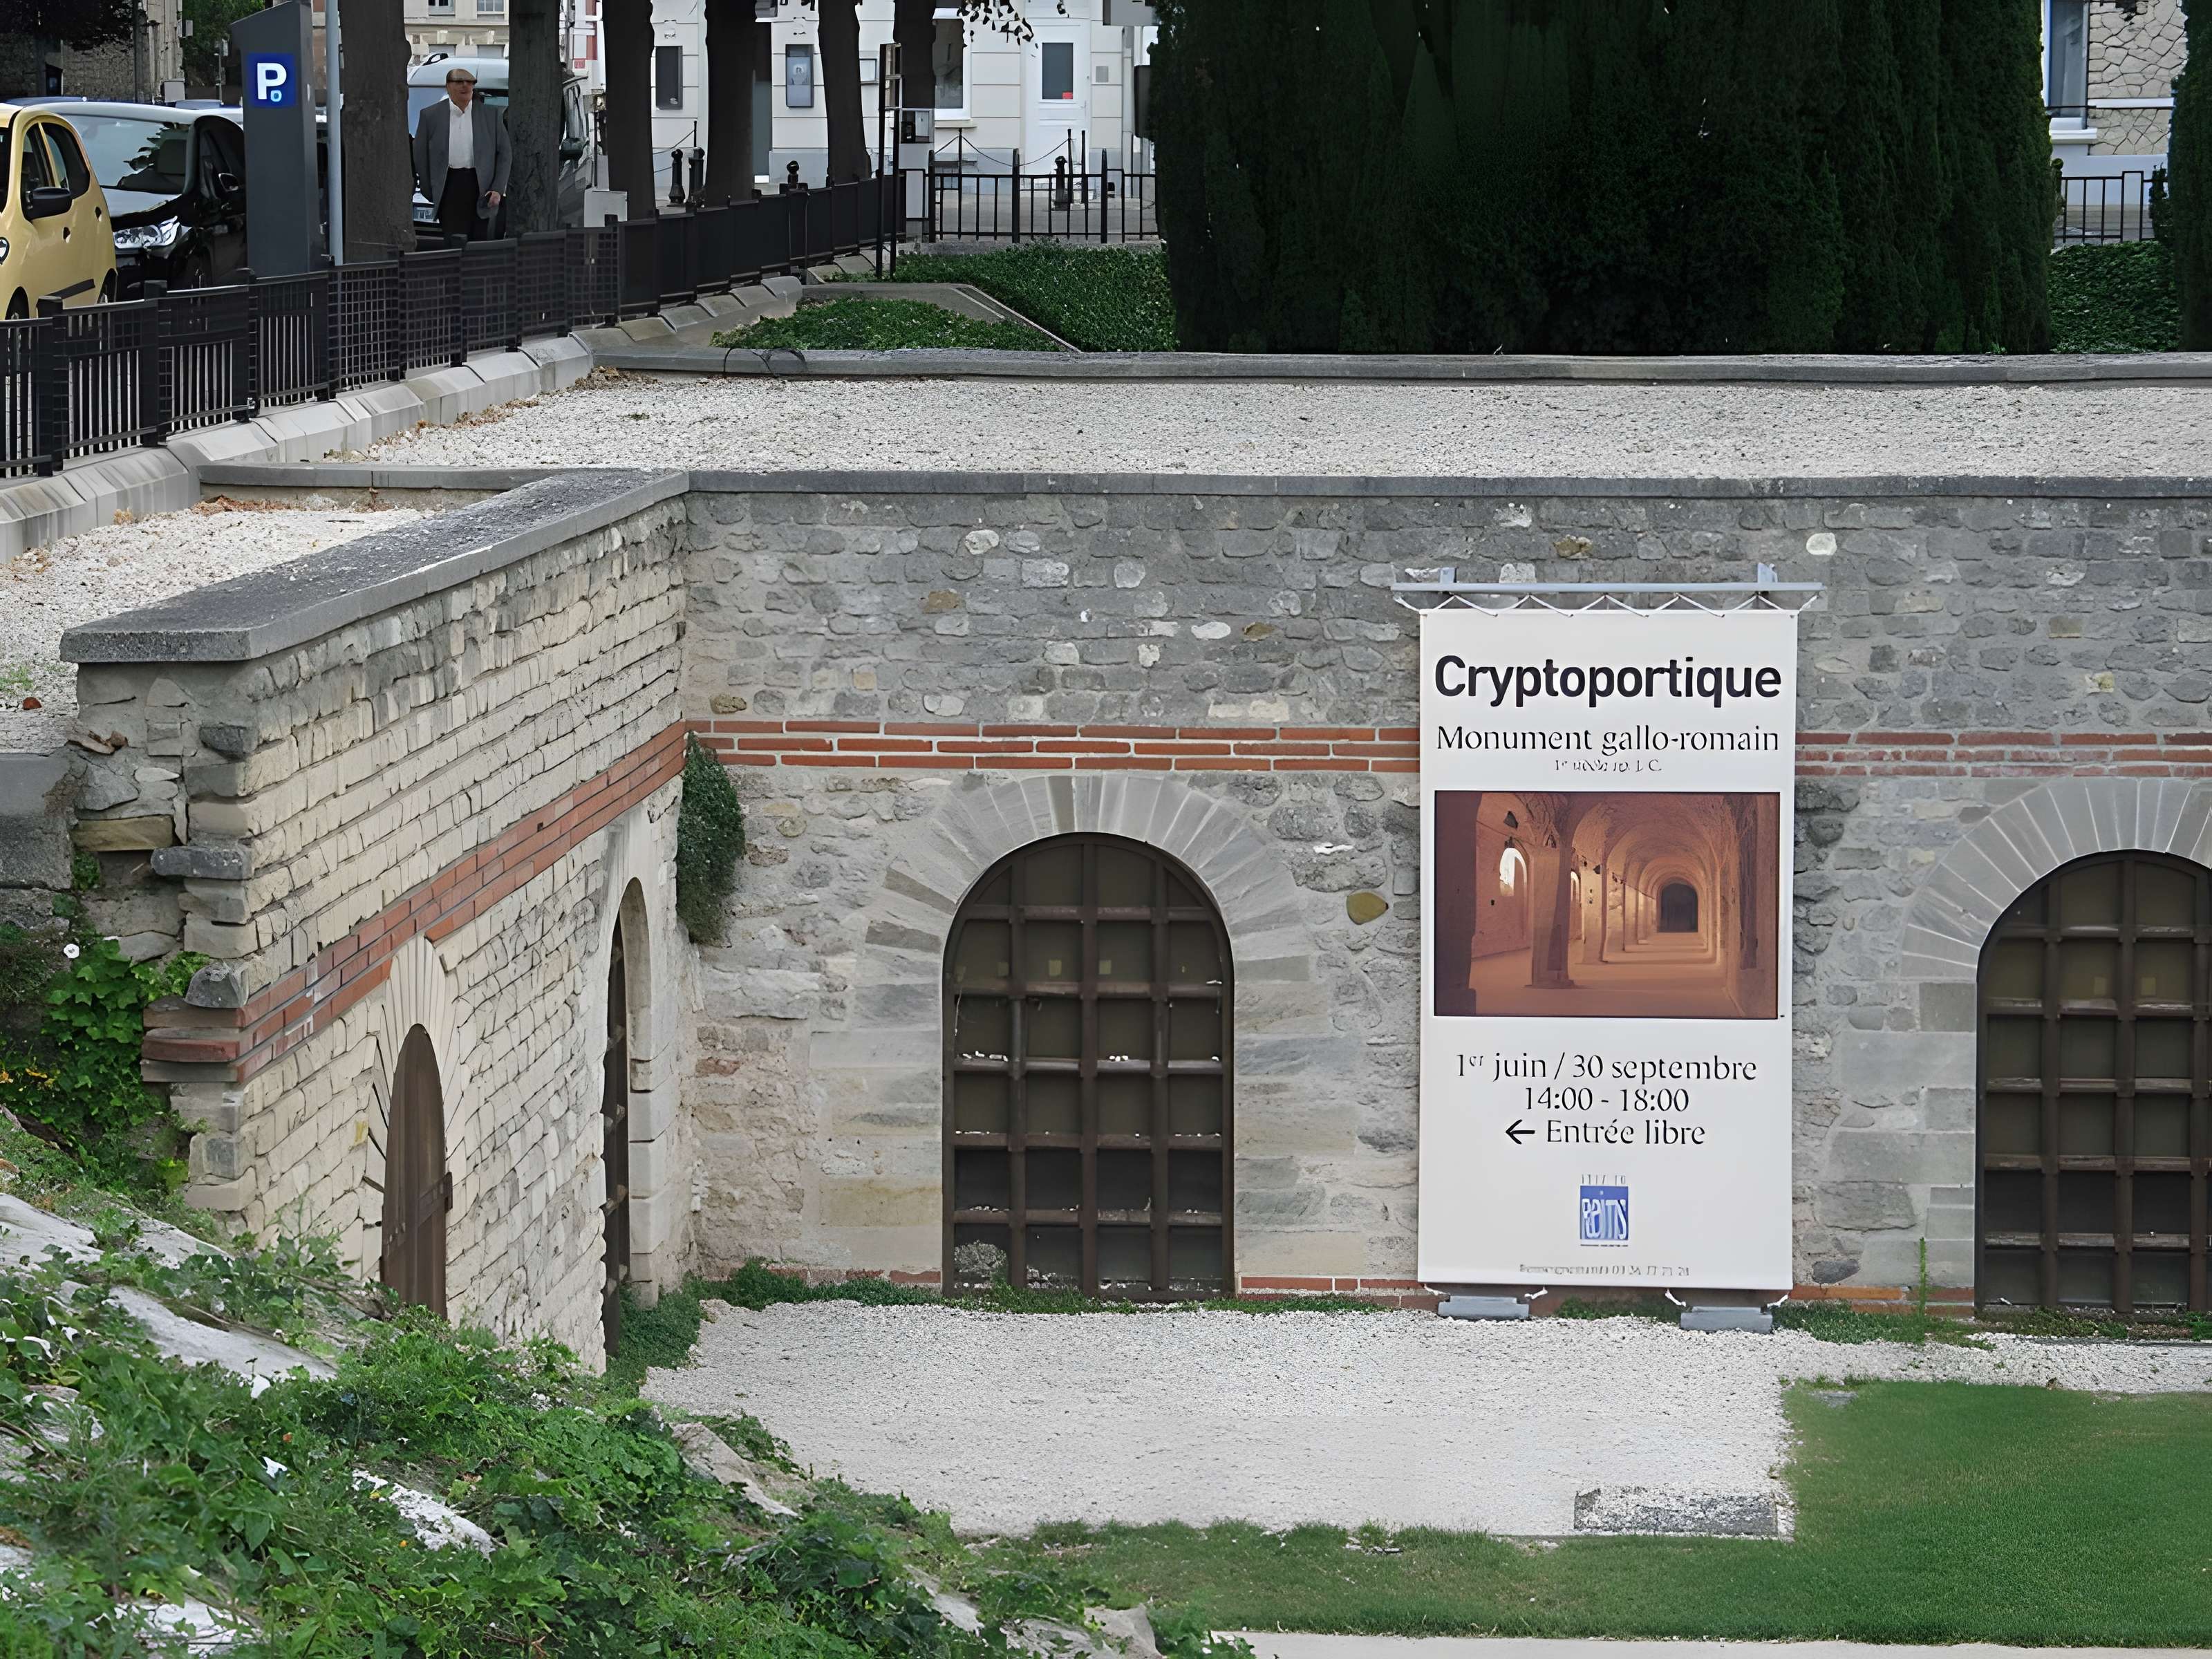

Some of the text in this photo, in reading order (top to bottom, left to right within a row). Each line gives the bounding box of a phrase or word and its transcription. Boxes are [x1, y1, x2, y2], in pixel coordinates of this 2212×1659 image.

[1434, 655, 1781, 709] Cryptoportique
[1437, 724, 1779, 756] Monument gallo-romain
[1492, 1052, 1547, 1082] juin
[1572, 1054, 1604, 1078] 30
[1611, 1055, 1757, 1085] septembre
[1525, 1087, 1593, 1112] 14:00
[1620, 1088, 1689, 1112] 18:00
[1546, 1118, 1706, 1145] Entrée libre
